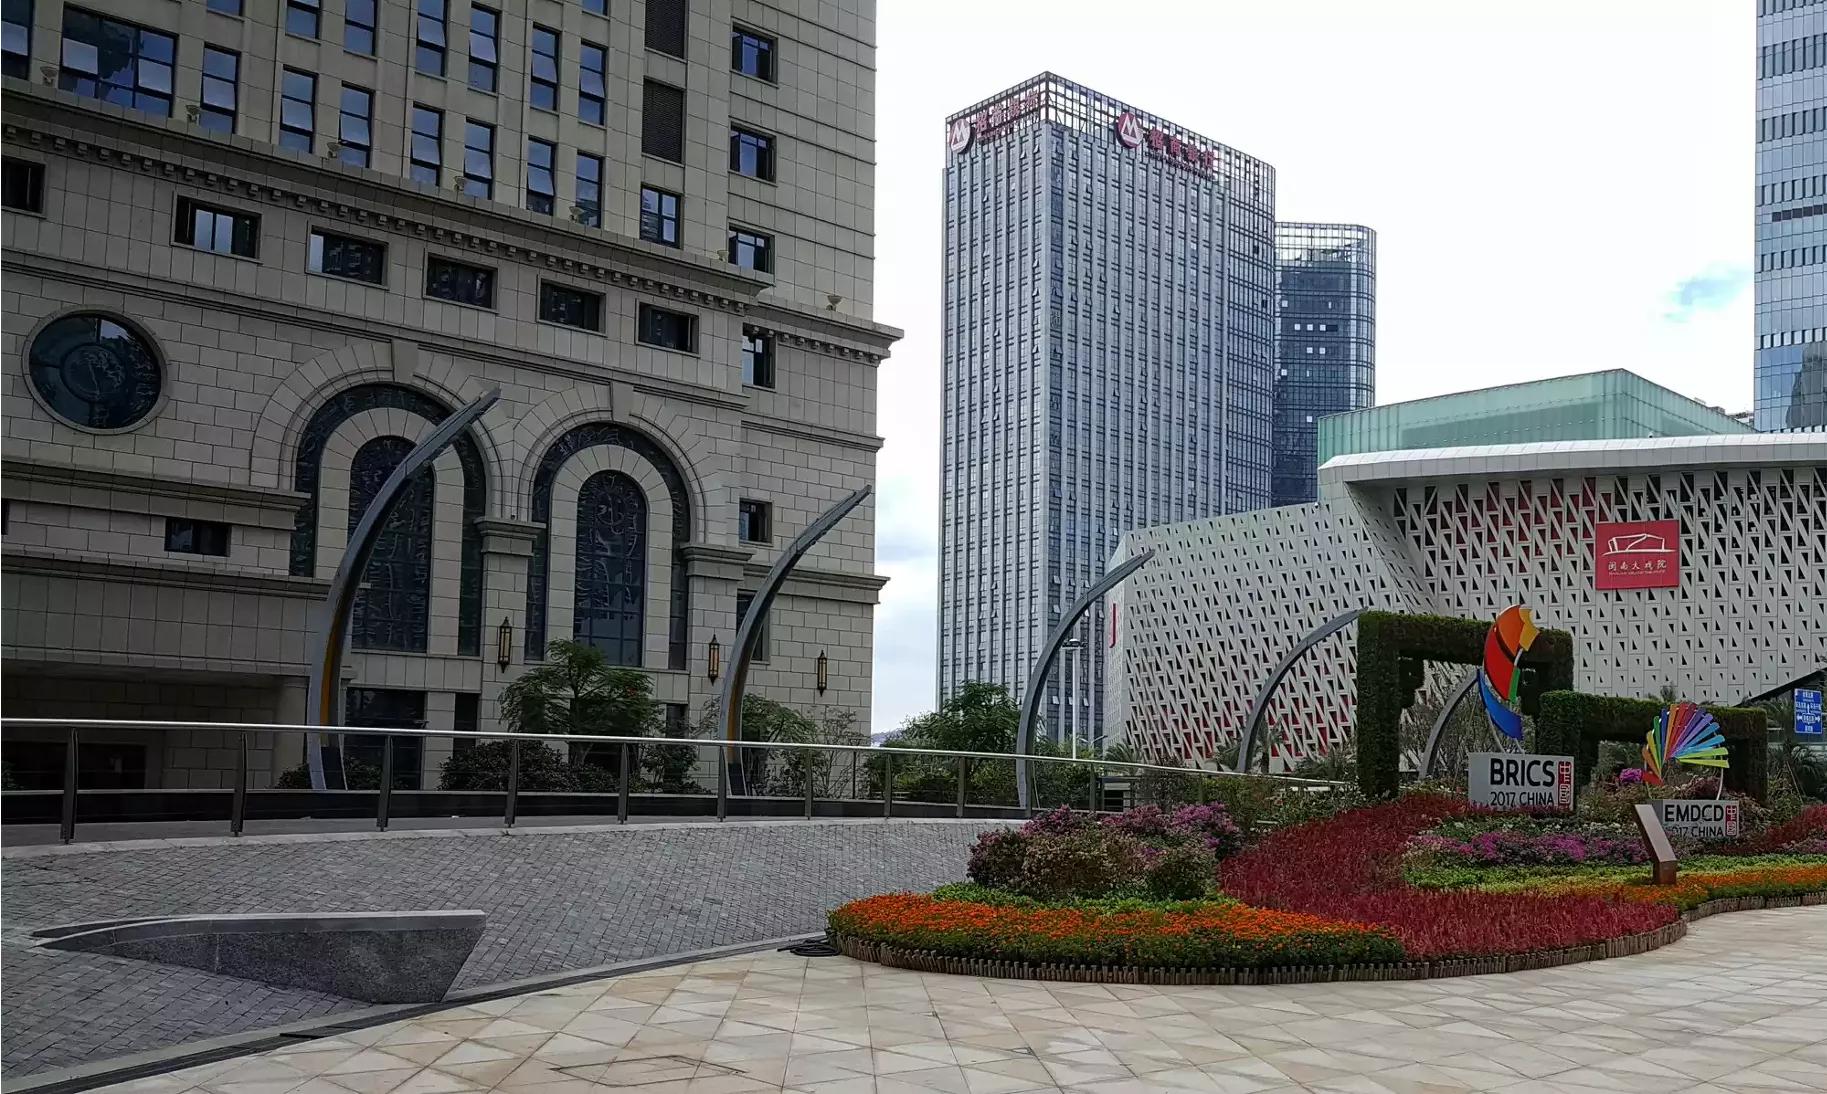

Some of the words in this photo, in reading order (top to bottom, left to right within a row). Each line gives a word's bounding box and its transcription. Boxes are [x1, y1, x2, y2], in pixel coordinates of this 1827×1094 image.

[1608, 560, 1667, 571] 闽南大戏院
[1490, 758, 1555, 787] BRICS
[1490, 791, 1516, 806] 2017
[1519, 791, 1554, 806] CHINA
[1664, 804, 1724, 822] EMDCD
[1690, 826, 1724, 838] CHINA
